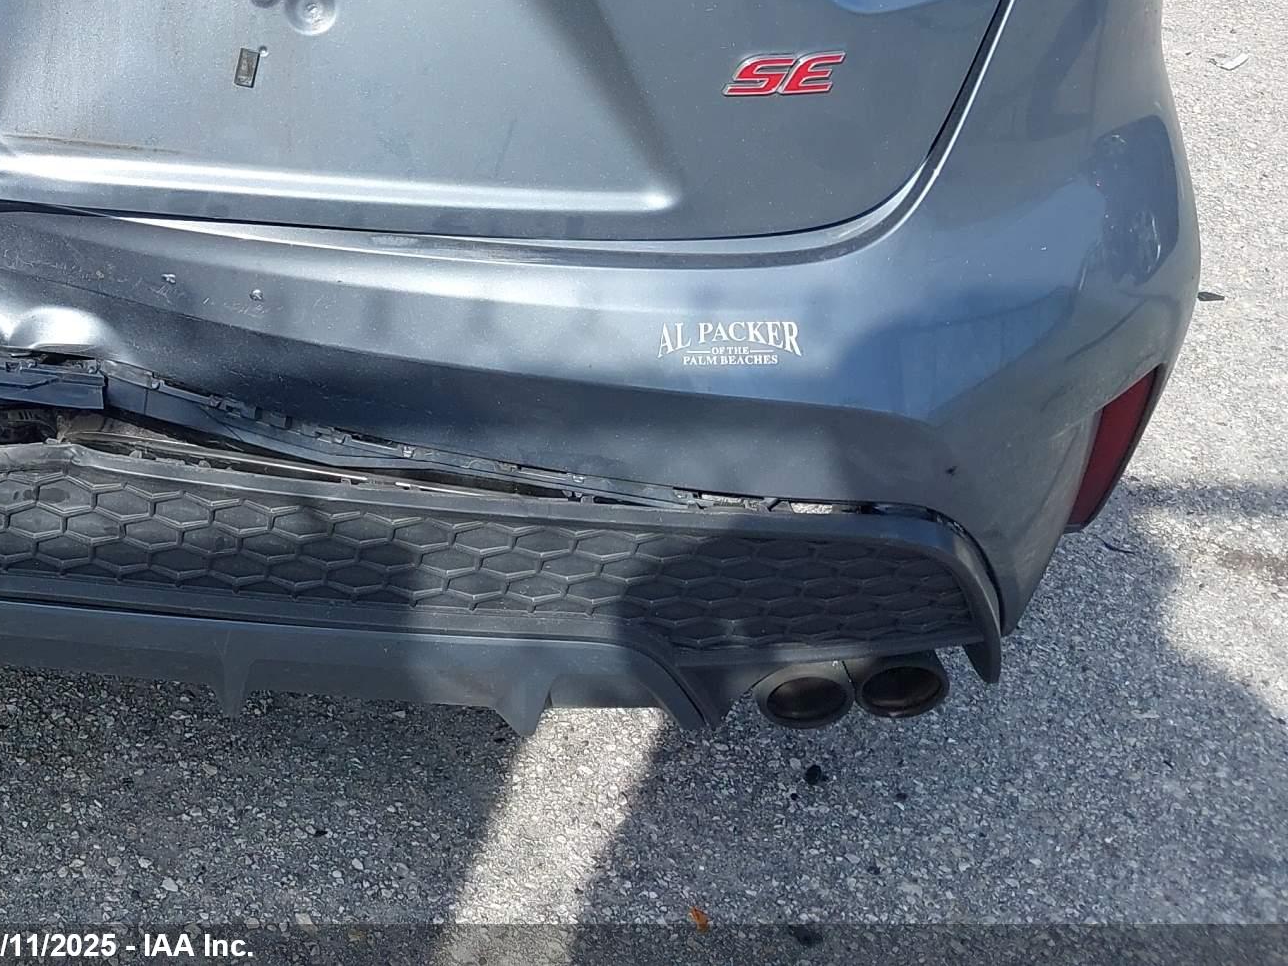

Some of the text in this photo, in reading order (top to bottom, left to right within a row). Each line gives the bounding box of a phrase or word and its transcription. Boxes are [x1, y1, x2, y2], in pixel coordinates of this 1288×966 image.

[722, 51, 846, 97] SE
[657, 321, 803, 359] AL PACKER
[711, 347, 750, 355] OF THE
[683, 354, 778, 366] PALM BEACHES
